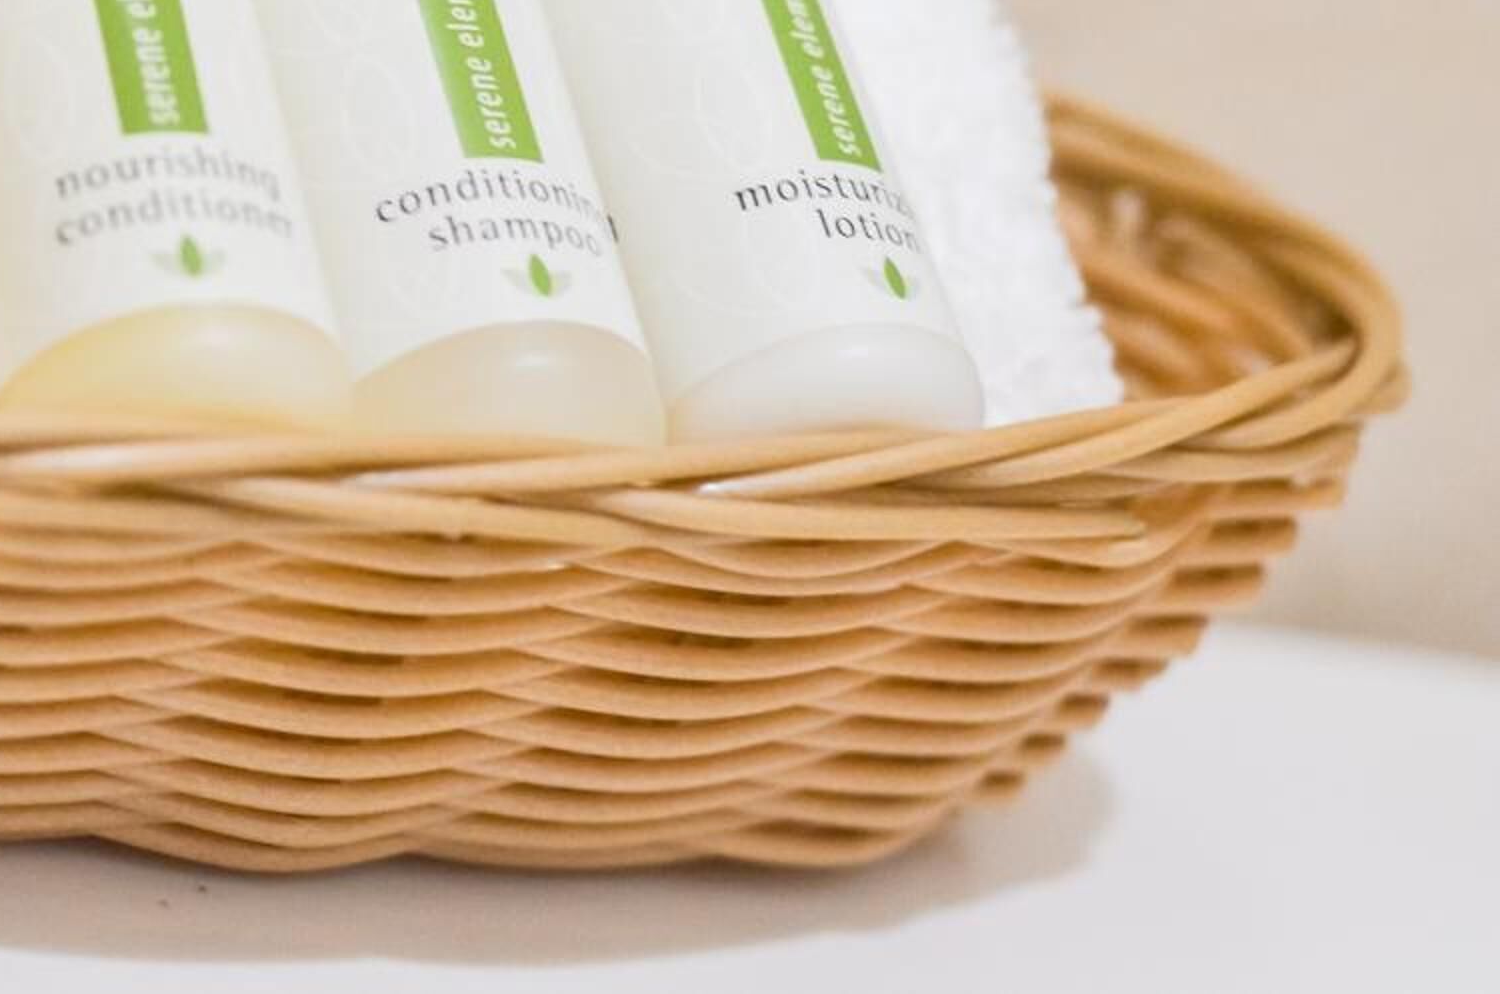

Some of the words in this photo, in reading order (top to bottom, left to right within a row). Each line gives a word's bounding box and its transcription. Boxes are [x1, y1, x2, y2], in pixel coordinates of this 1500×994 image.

[132, 28, 180, 127] serene
[466, 56, 517, 151] serene
[810, 63, 863, 158] serene
[54, 145, 281, 203] nourishing
[428, 214, 604, 258] shampoo
[815, 207, 922, 255] lotion
